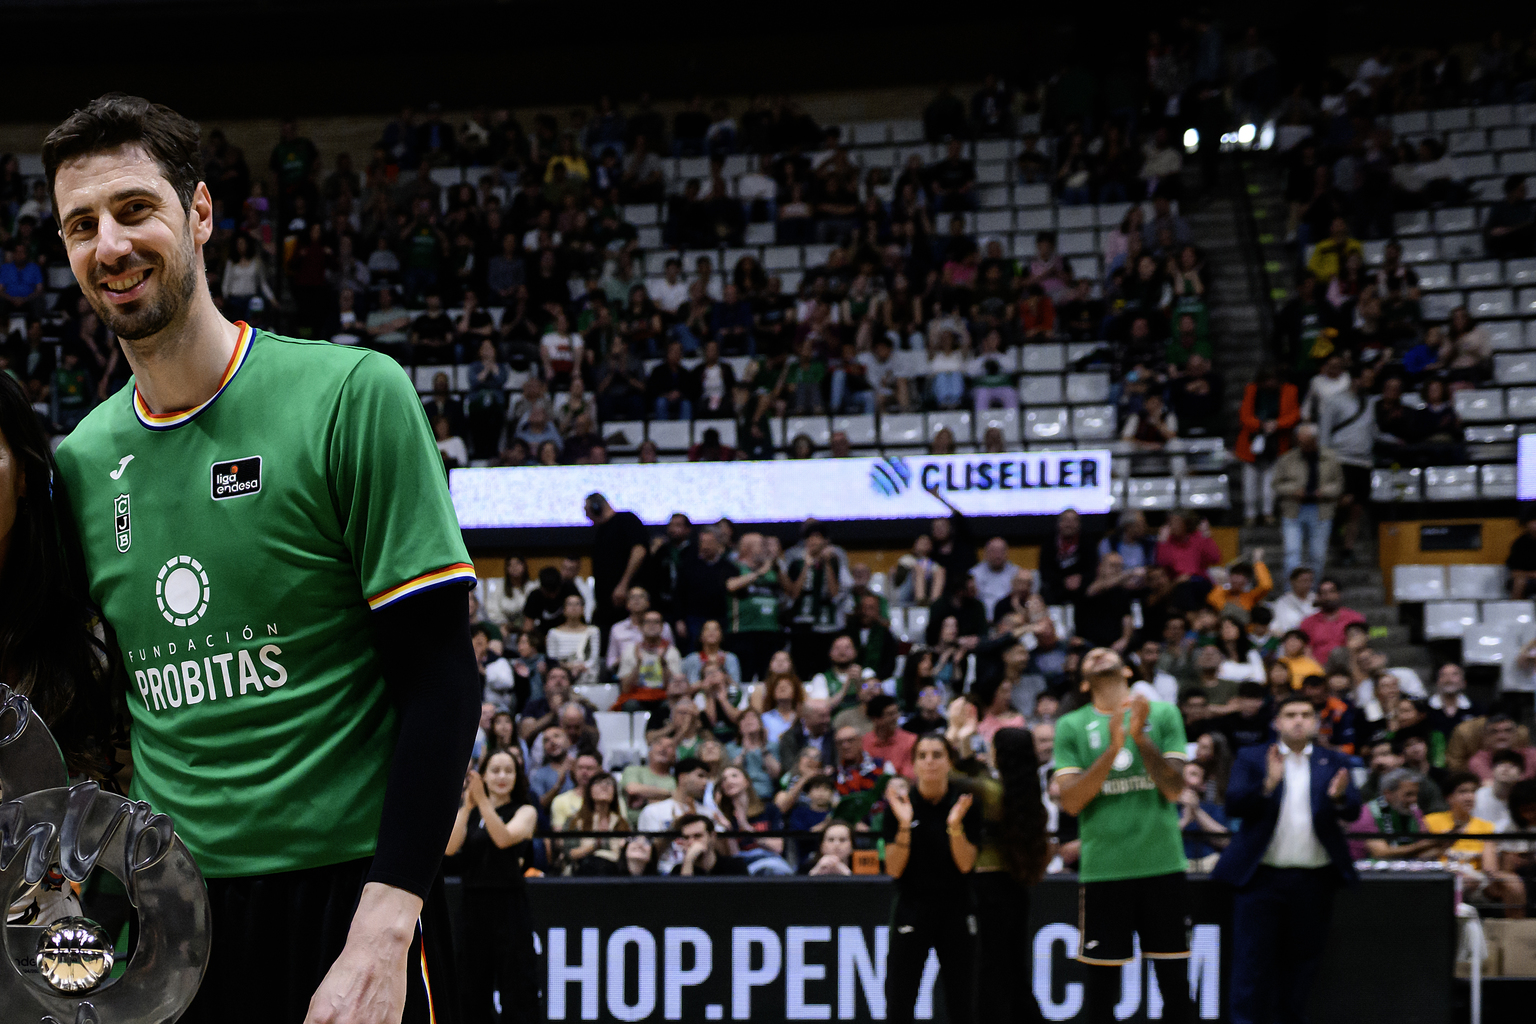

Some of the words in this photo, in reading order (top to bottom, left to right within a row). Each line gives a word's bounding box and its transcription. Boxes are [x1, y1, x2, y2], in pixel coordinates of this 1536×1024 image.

[216, 473, 237, 485] liga
[216, 479, 258, 495] endesa
[921, 458, 1099, 492] CLISELLER
[128, 622, 278, 662] FUNDACIÓN
[134, 644, 288, 711] PROBITAS
